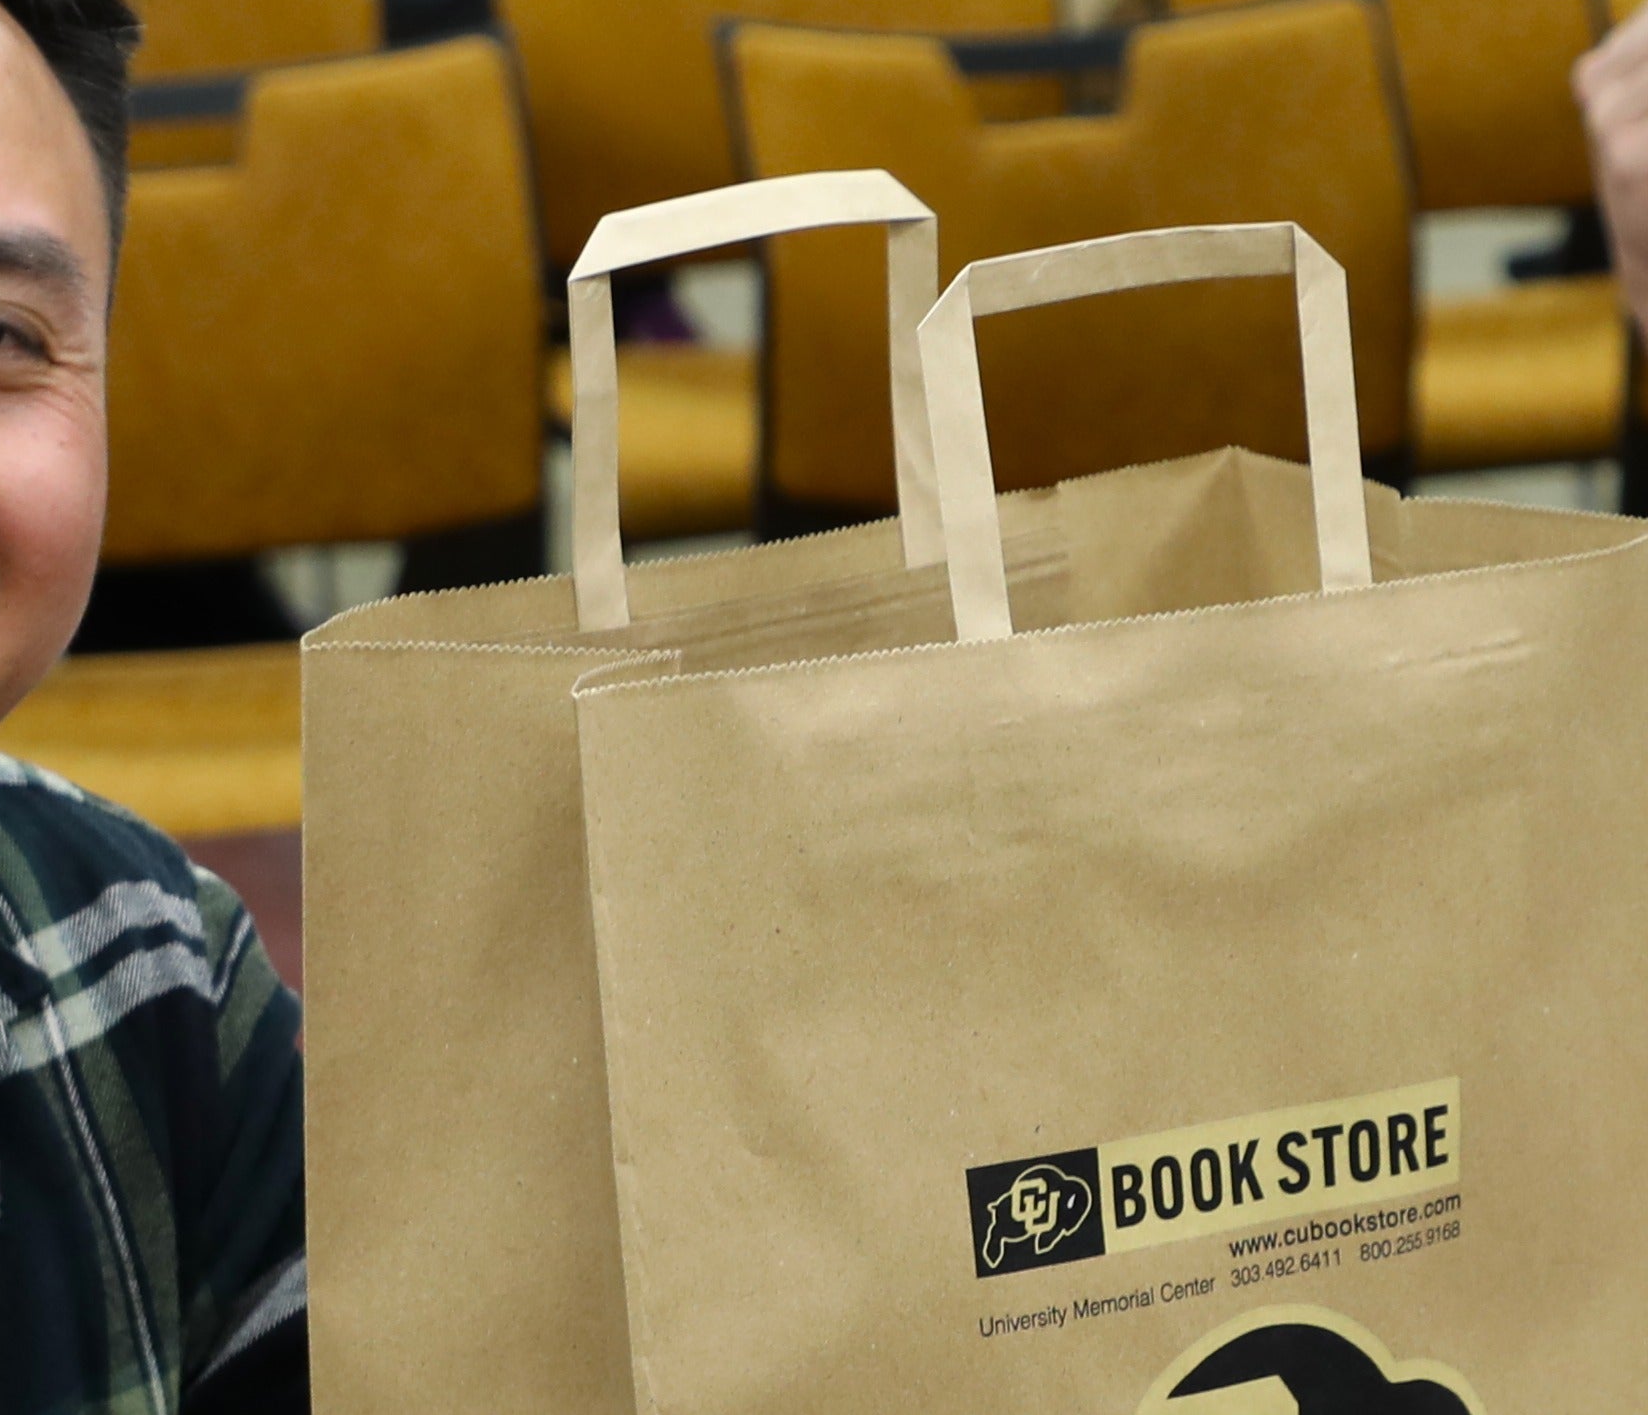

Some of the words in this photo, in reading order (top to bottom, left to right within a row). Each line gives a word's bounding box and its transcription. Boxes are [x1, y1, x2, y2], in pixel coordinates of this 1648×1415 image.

[1111, 1136, 1265, 1230] BOOK
[1276, 1103, 1450, 1195] STORE
[1228, 1192, 1462, 1259] www.cubookstore.com
[978, 1303, 1068, 1338] University
[1073, 1287, 1155, 1321] Memorial
[1160, 1274, 1216, 1305] Center
[1230, 1248, 1343, 1289] 303.492.6411
[1359, 1220, 1462, 1263] 800.255.9168
